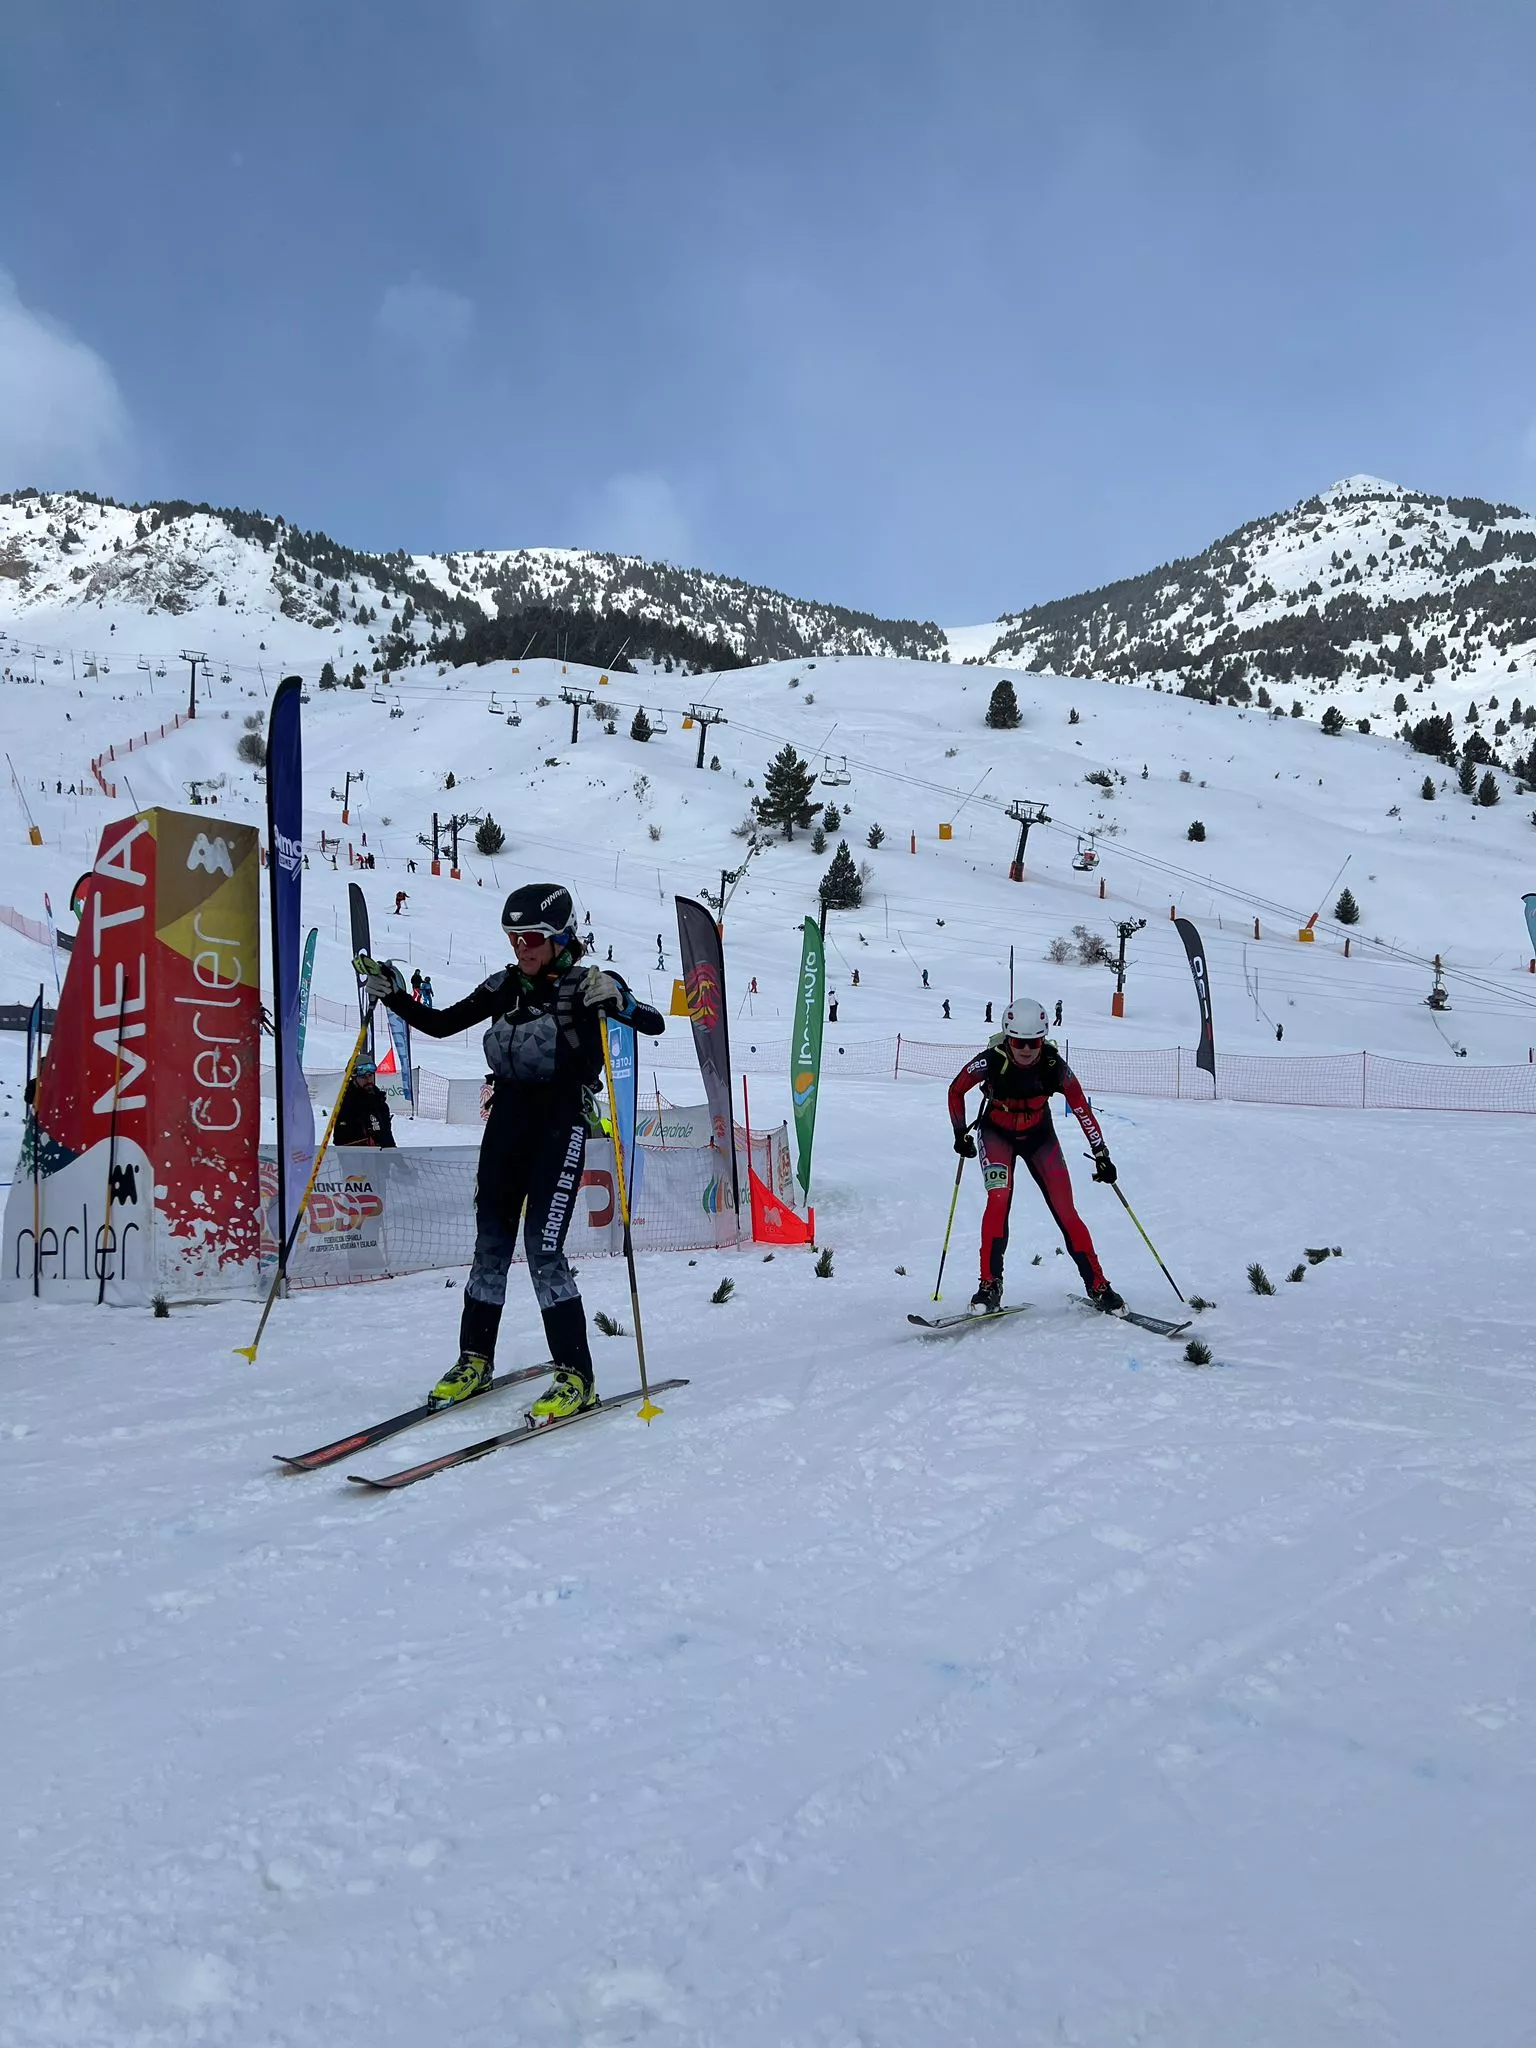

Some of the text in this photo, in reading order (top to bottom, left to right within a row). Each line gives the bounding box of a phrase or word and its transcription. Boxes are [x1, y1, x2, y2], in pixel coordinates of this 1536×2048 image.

[540, 888, 567, 911] DYNAFI
[92, 819, 149, 1114] META
[174, 912, 241, 1131] cerler
[542, 1125, 584, 1252] EJÉRCITO DE TIERRA
[985, 1170, 1007, 1182] 106
